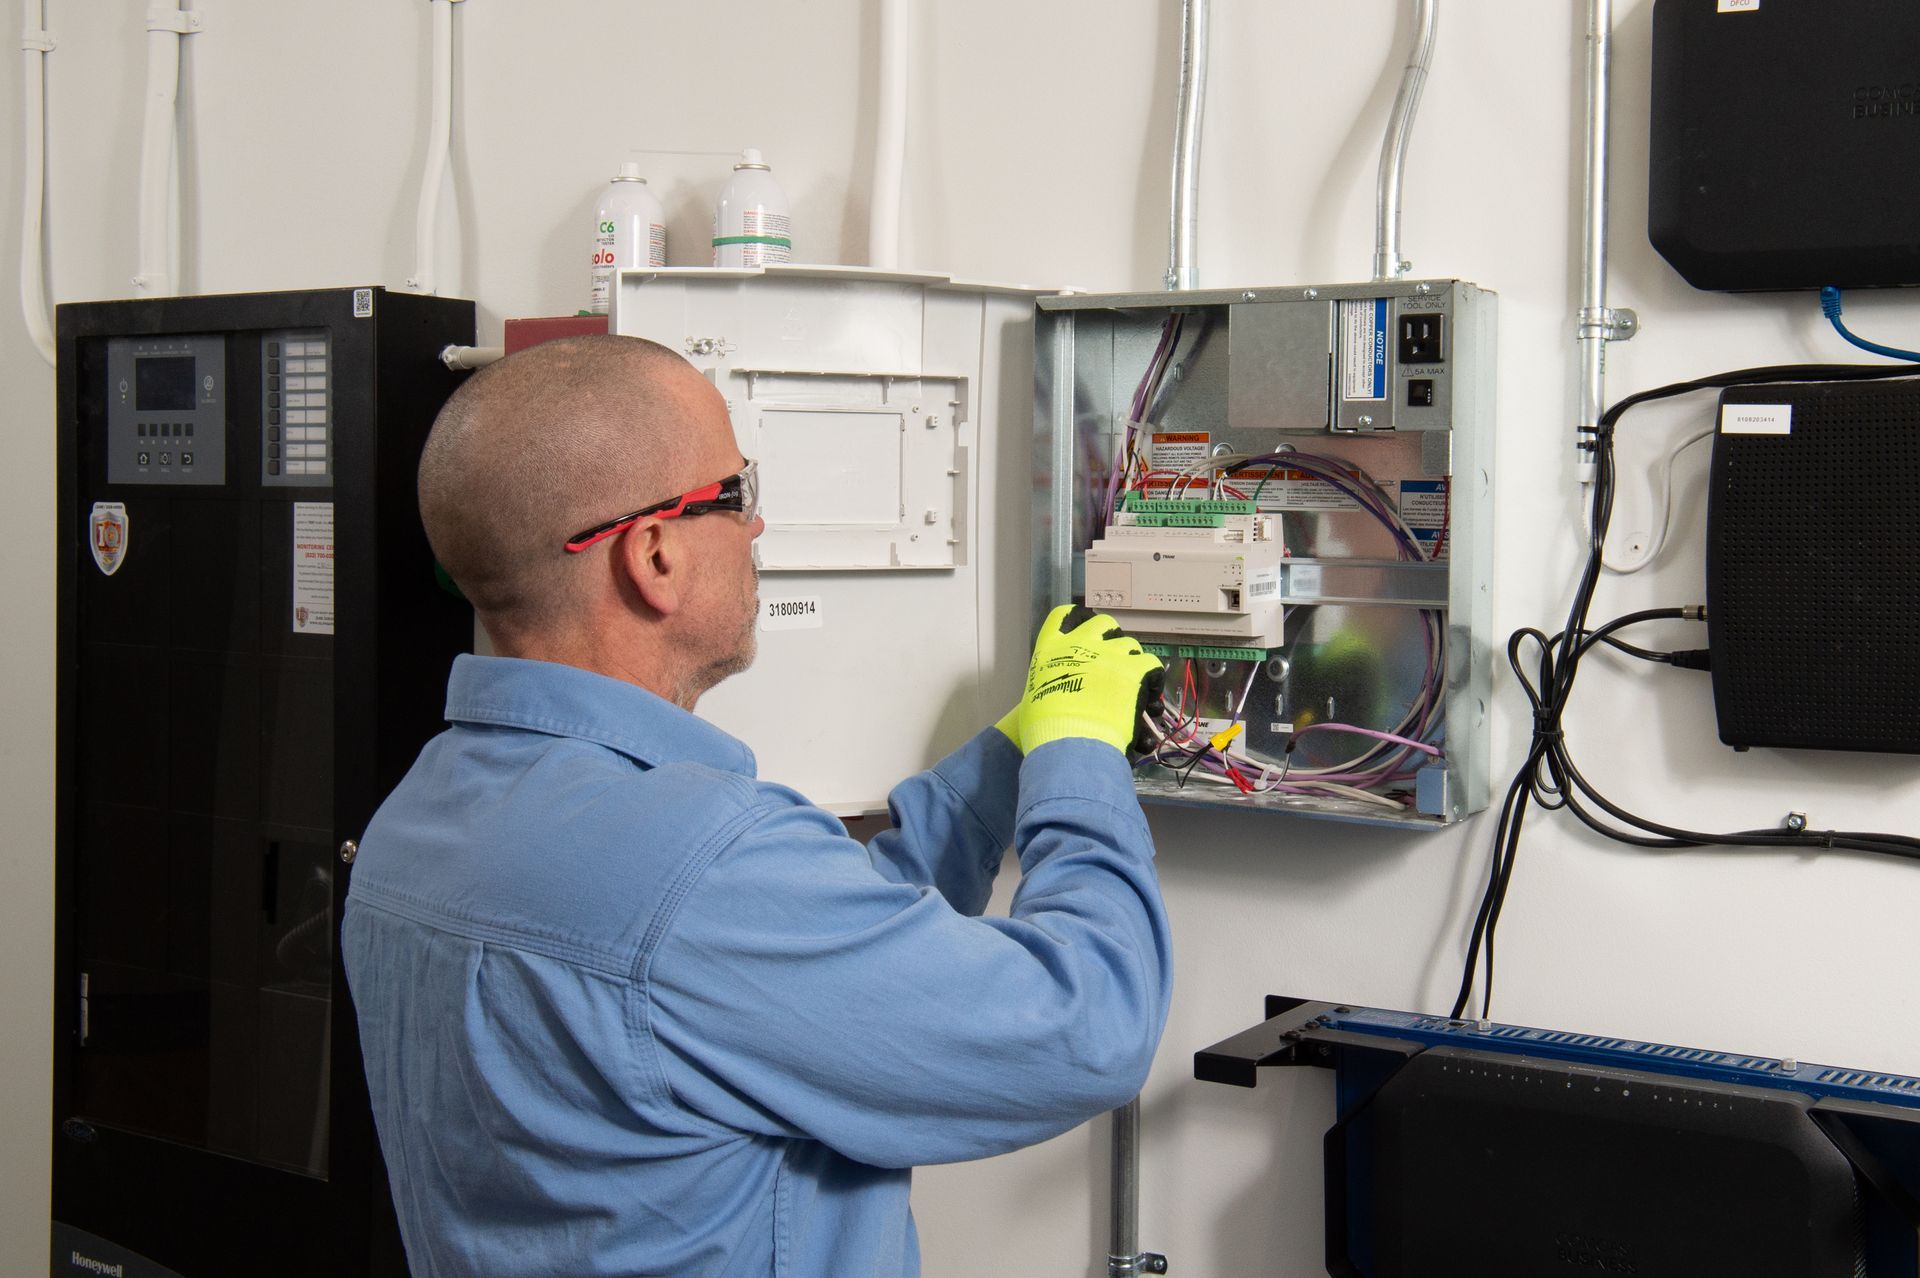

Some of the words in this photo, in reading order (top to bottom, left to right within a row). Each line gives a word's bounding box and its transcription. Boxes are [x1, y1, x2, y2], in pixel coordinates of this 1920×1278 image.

[600, 222, 614, 233] C6
[769, 601, 816, 616] 31800914
[72, 1250, 123, 1278] Honeywell
